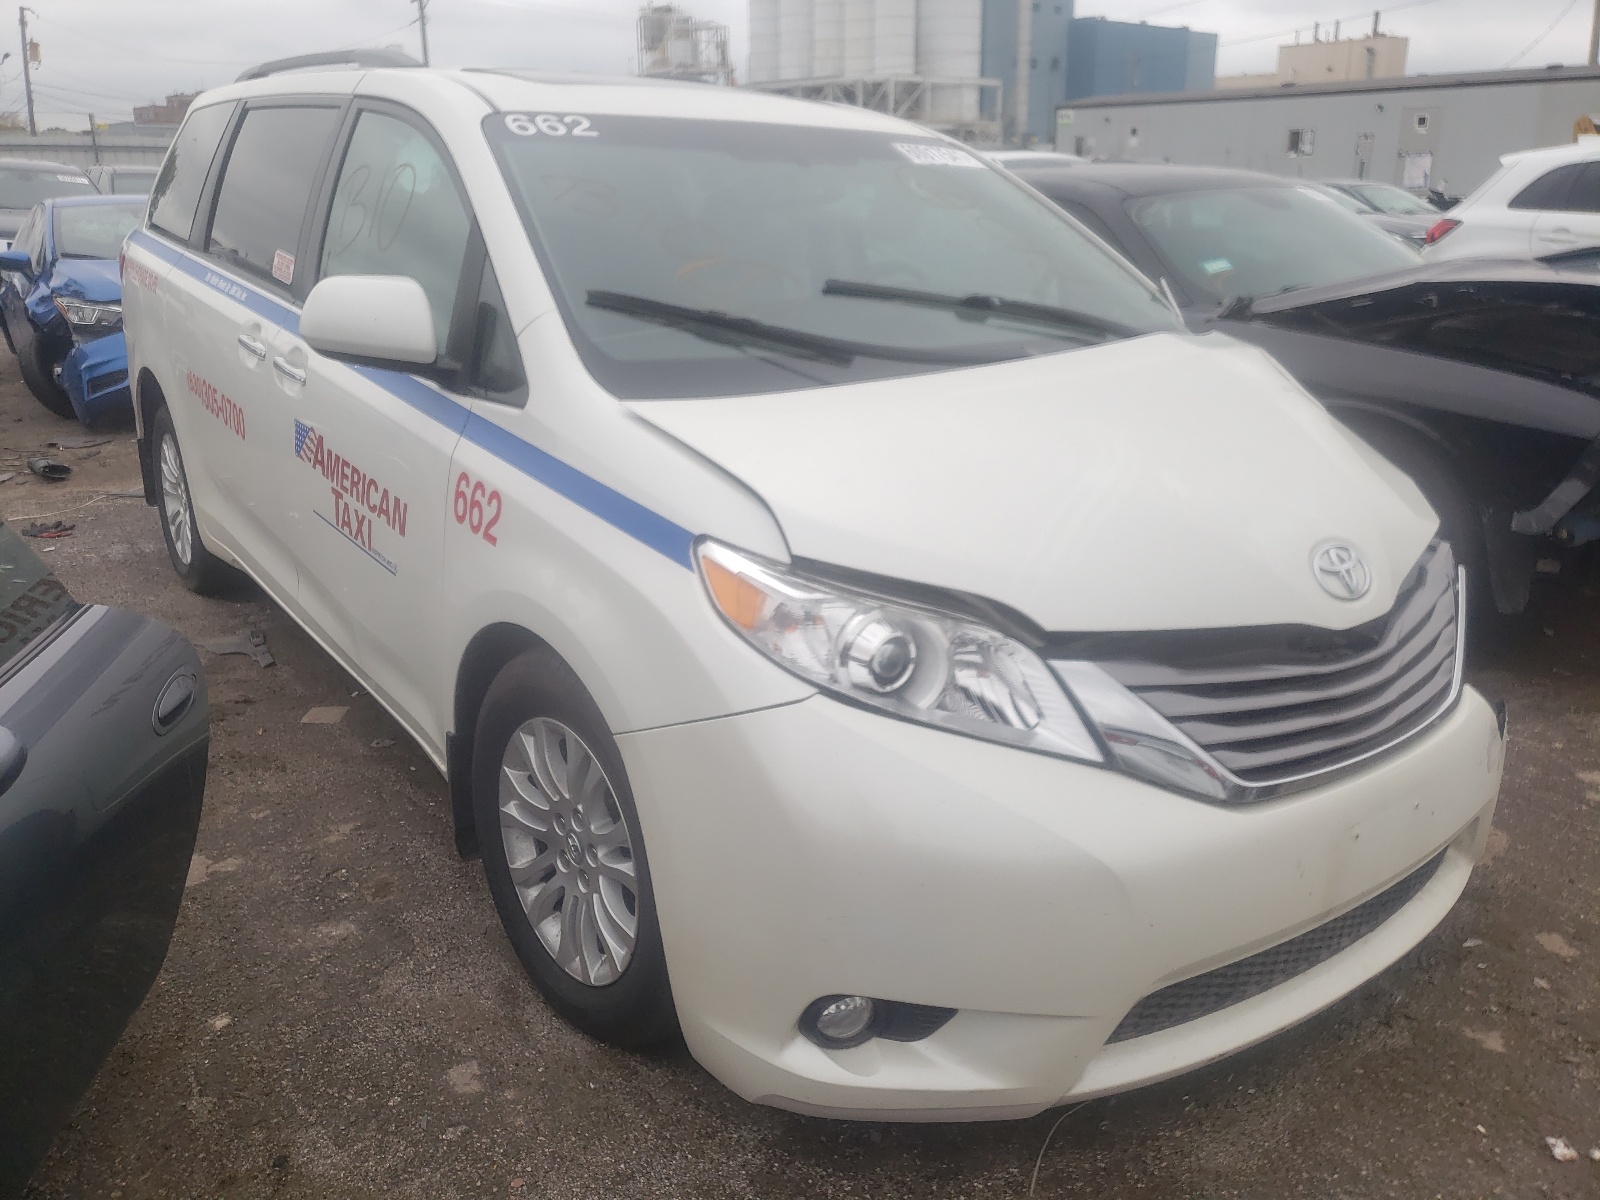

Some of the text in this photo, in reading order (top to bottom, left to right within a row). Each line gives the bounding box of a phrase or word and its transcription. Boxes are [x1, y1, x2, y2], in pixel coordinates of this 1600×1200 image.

[504, 113, 600, 137] 662
[311, 434, 408, 538] AMERICAN
[331, 486, 373, 552] TAXI
[453, 471, 503, 548] 662
